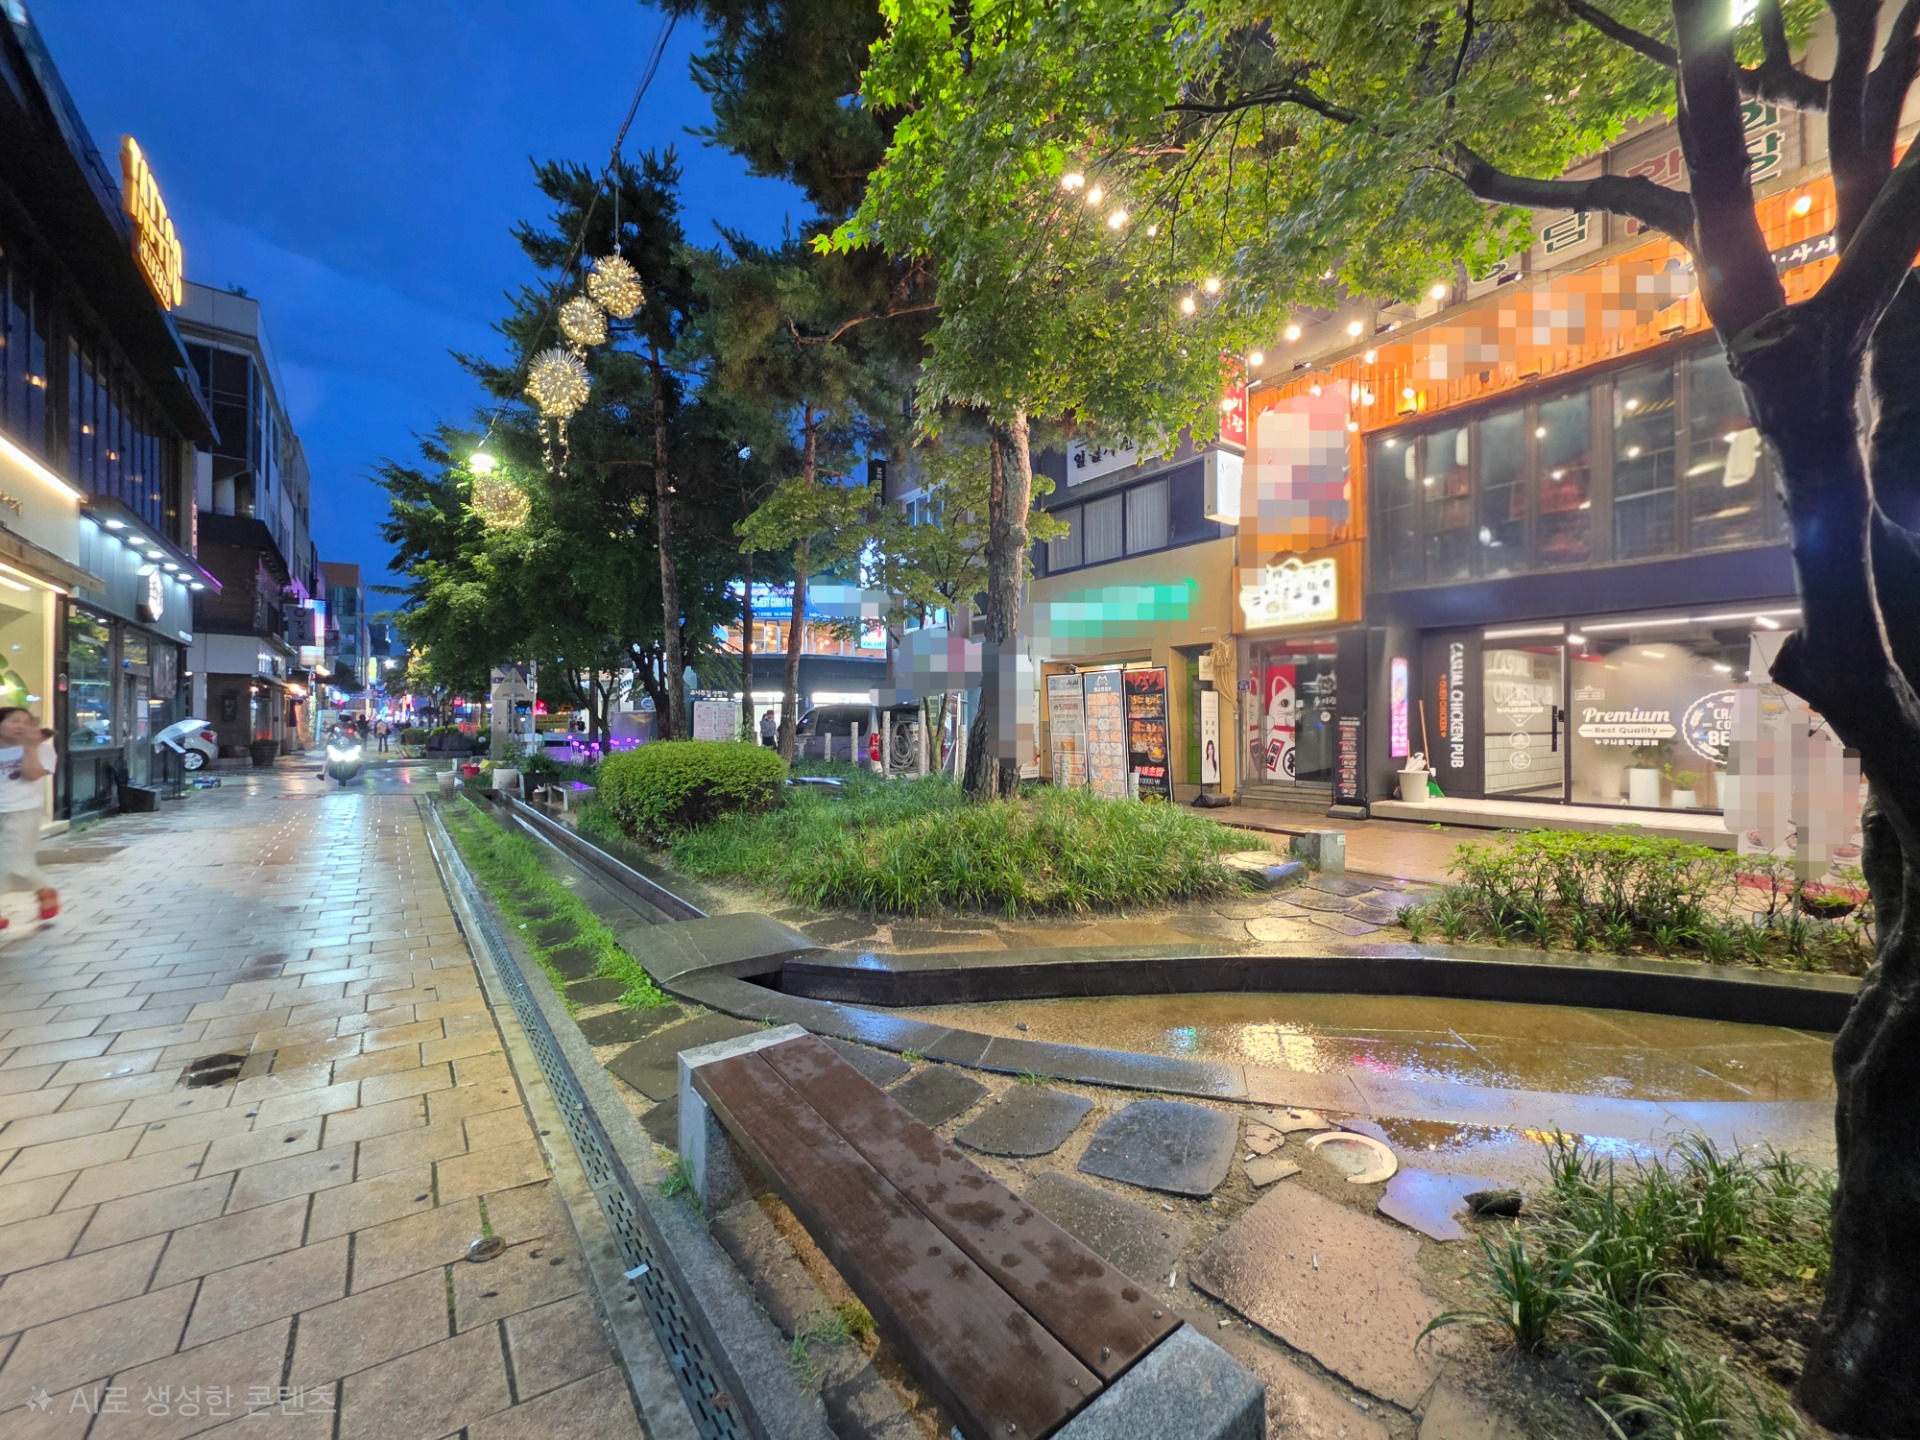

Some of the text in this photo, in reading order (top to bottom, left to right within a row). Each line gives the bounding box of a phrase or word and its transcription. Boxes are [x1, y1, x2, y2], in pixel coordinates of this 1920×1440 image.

[1439, 680, 1448, 732] OVEN CHICKEN
[1450, 642, 1465, 769] CASUAL CHICKEN PUB
[1582, 707, 1671, 723] Premium
[1594, 726, 1658, 736] Best Quality
